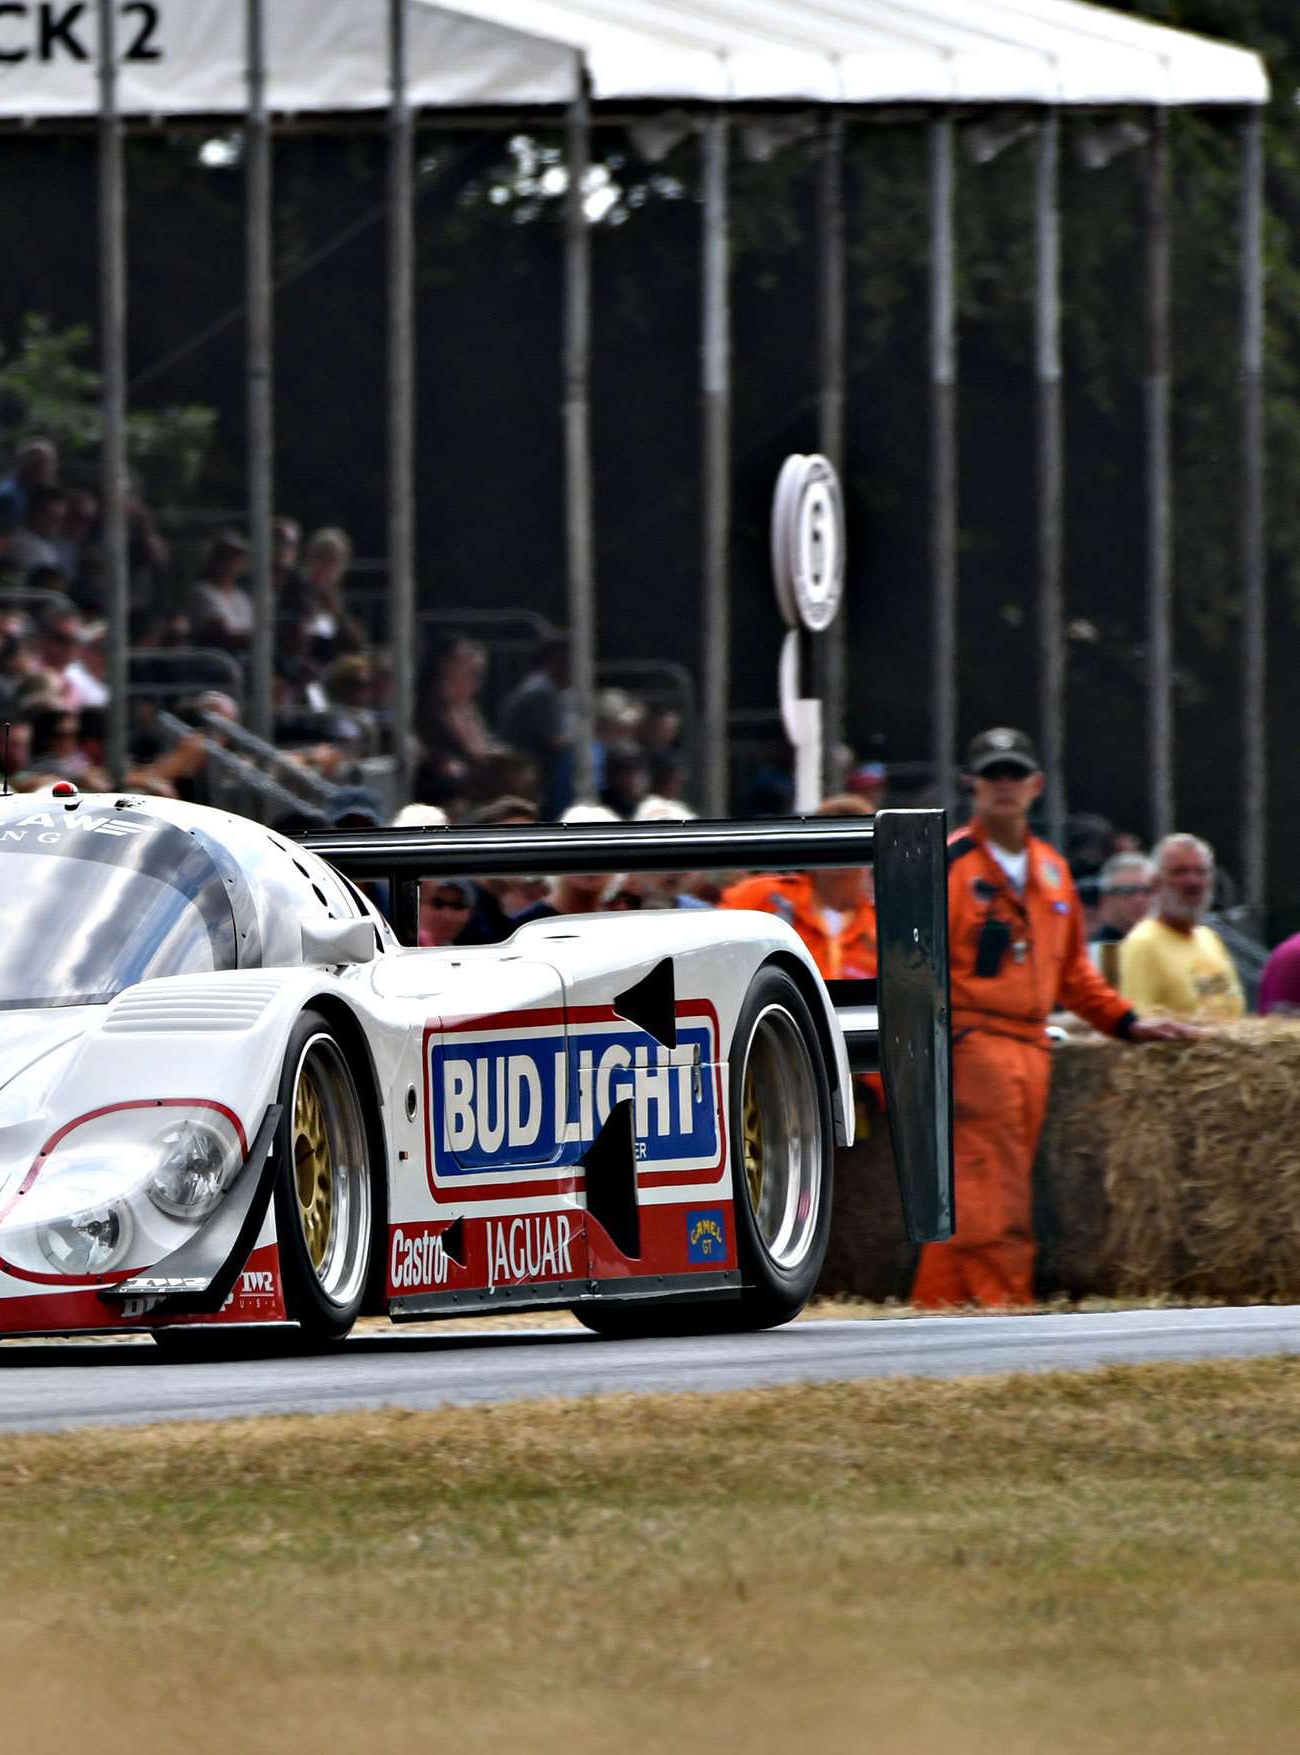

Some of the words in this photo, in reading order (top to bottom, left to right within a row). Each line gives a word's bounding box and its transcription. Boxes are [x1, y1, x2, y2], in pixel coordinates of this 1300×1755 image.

[120, 2, 162, 63] 2
[442, 1054, 543, 1154] BUD
[554, 1043, 701, 1144] LIGHT
[690, 1219, 723, 1245] CAMEL
[702, 1238, 713, 1255] GT
[485, 1215, 573, 1295] JAGUAR
[241, 1271, 275, 1292] TWR
